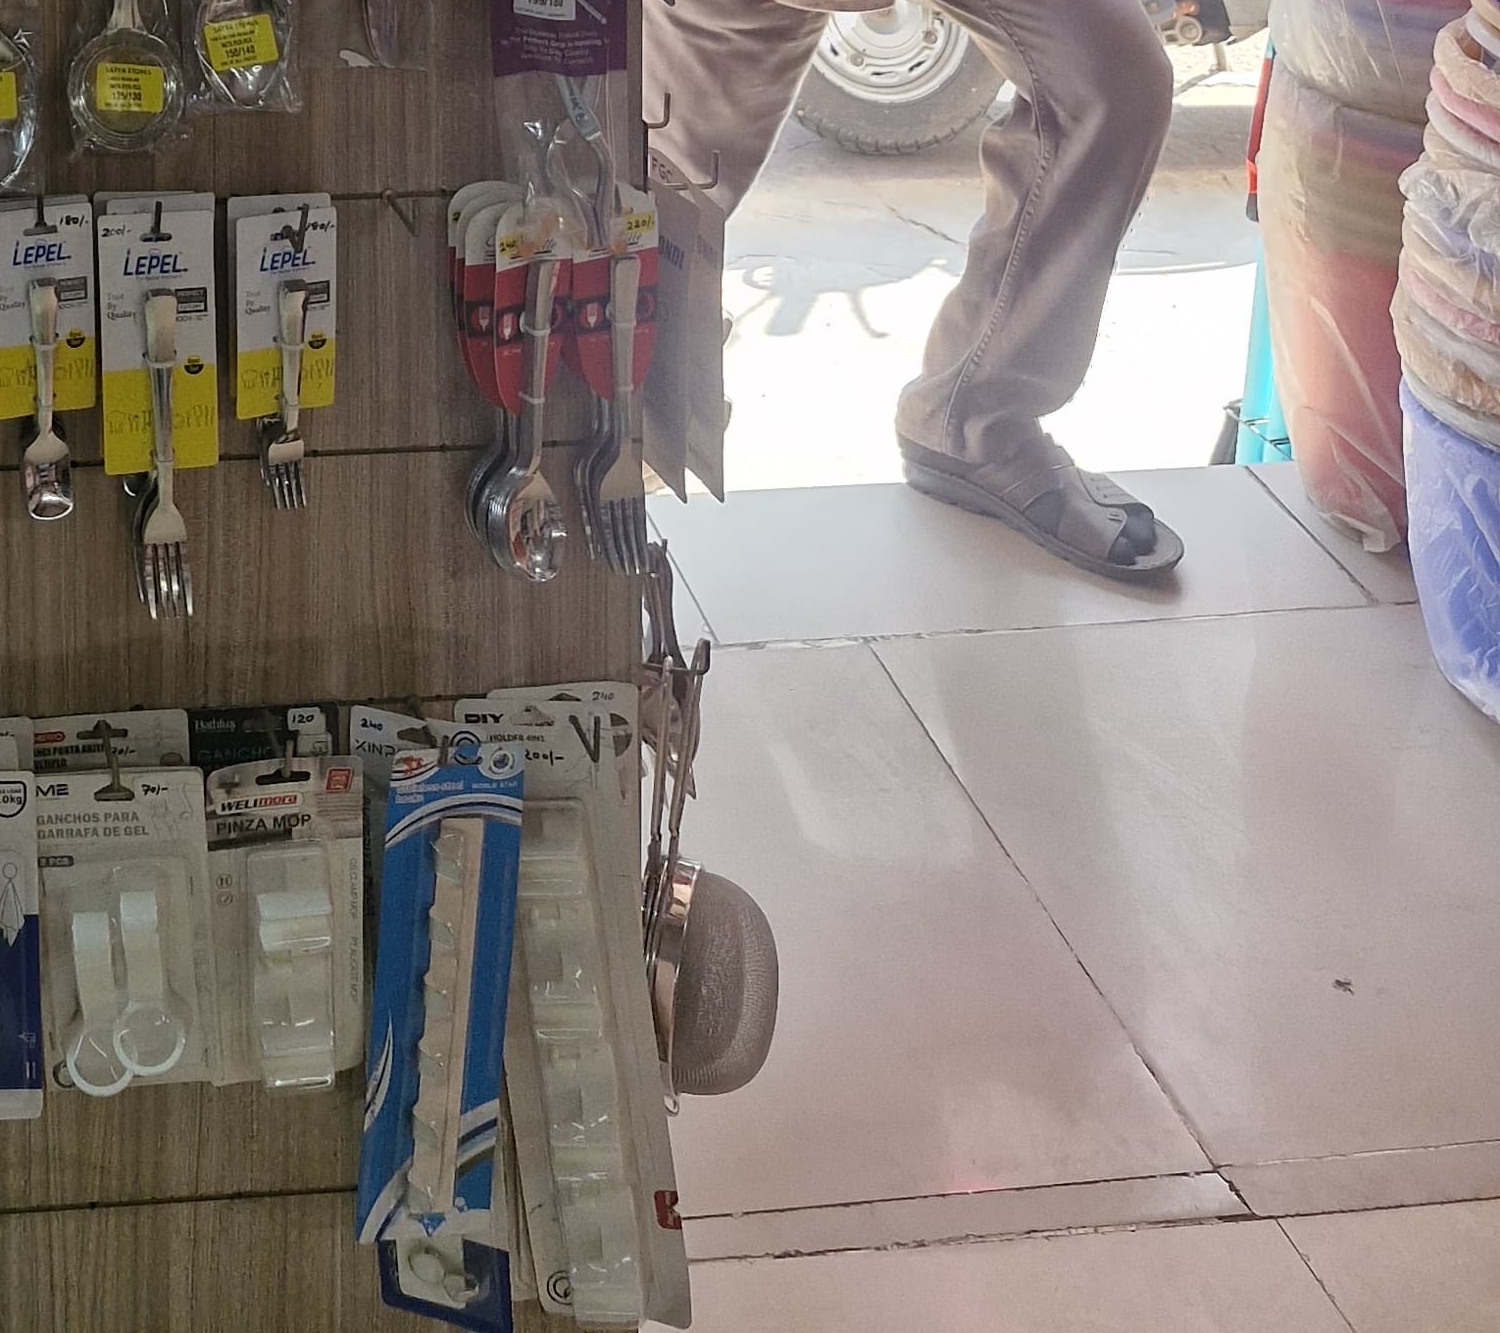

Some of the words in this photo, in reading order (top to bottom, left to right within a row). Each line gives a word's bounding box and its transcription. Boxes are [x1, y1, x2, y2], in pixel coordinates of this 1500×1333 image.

[225, 45, 255, 58] 150/140
[60, 214, 89, 227] 180/-
[102, 225, 132, 238] 200/-
[13, 242, 73, 266] LEPEL
[123, 250, 189, 275] LEPEL
[291, 712, 315, 724] 120
[360, 719, 383, 730] 240
[525, 750, 564, 765] 200/-
[142, 784, 168, 796] 70/-
[36, 813, 100, 825] GANCHOS
[102, 811, 140, 824] PARA
[216, 819, 270, 834] PINZA
[273, 814, 312, 829] MOP
[102, 826, 119, 838] DE
[121, 826, 149, 838] GEL
